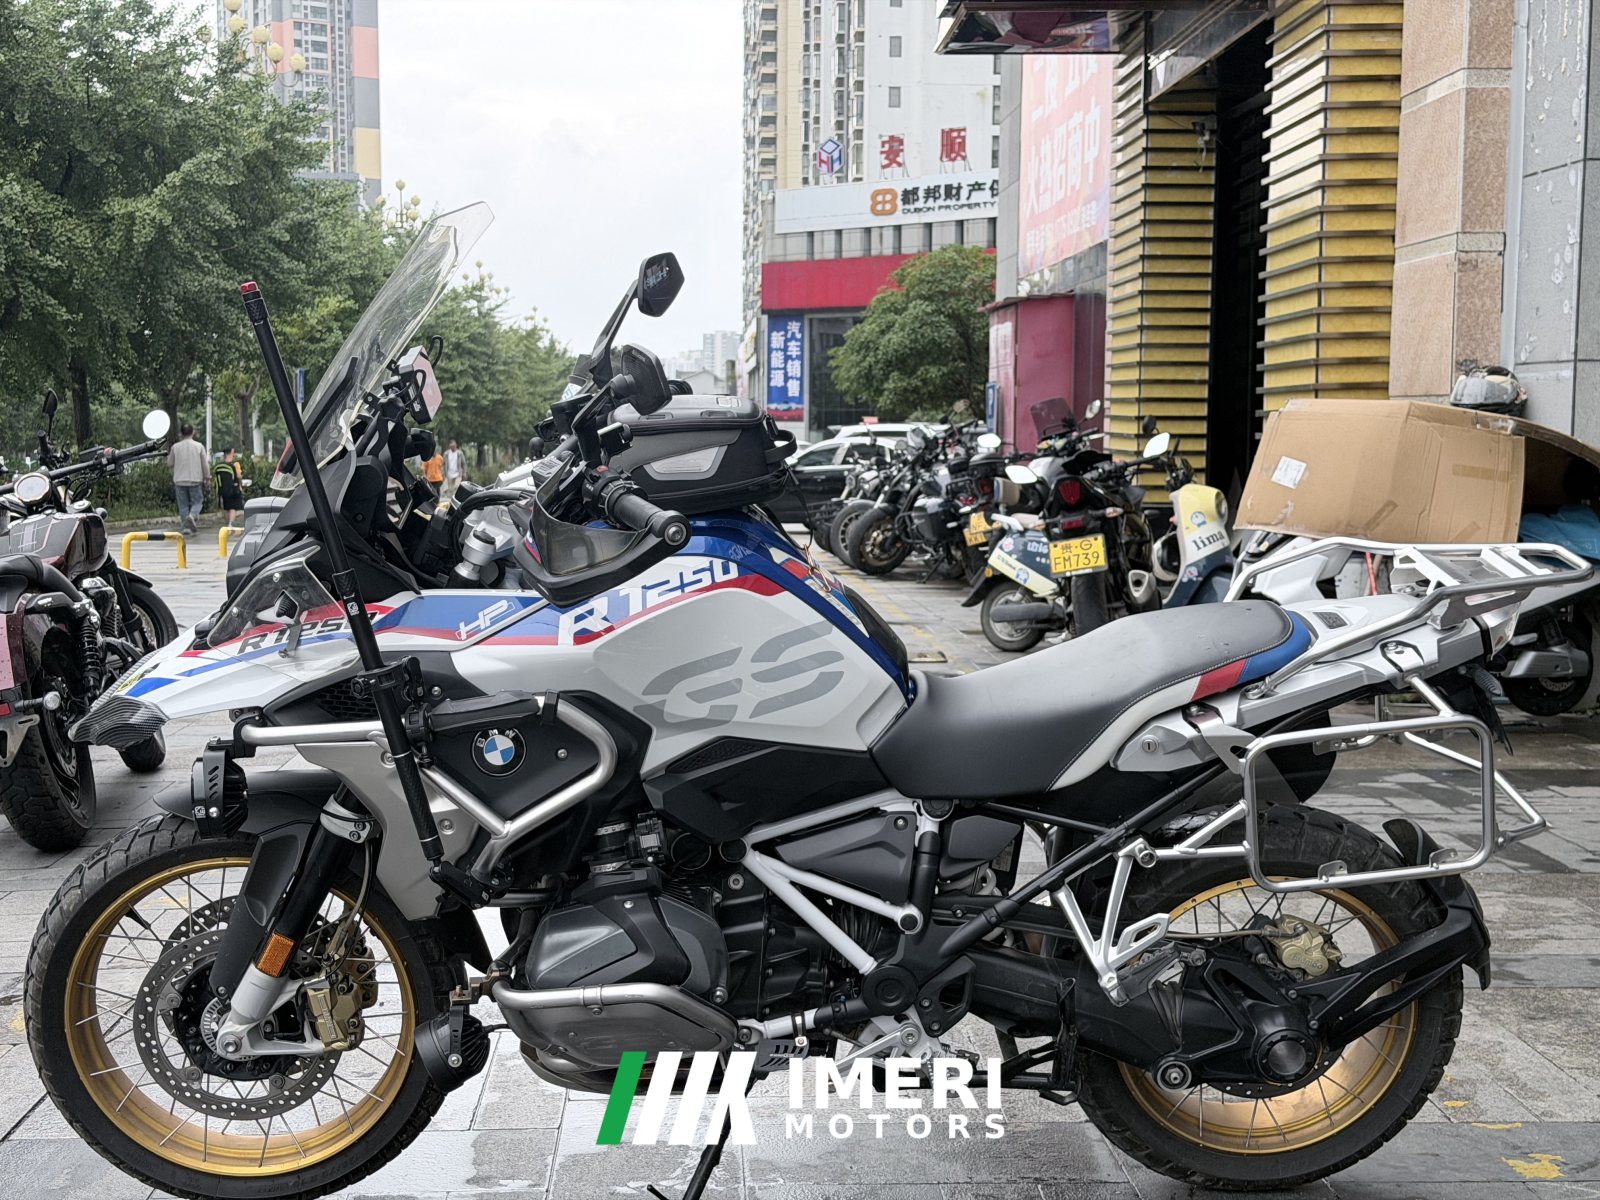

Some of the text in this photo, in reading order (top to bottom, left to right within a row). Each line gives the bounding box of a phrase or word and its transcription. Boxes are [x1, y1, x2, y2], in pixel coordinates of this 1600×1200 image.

[938, 201, 996, 212] PROPERTY
[769, 331, 786, 388] 新能源
[786, 321, 802, 397] 汽车销售
[1192, 530, 1225, 551] lima
[1054, 551, 1100, 571] FM739
[633, 619, 845, 741] GS
[475, 728, 517, 748] BMW
